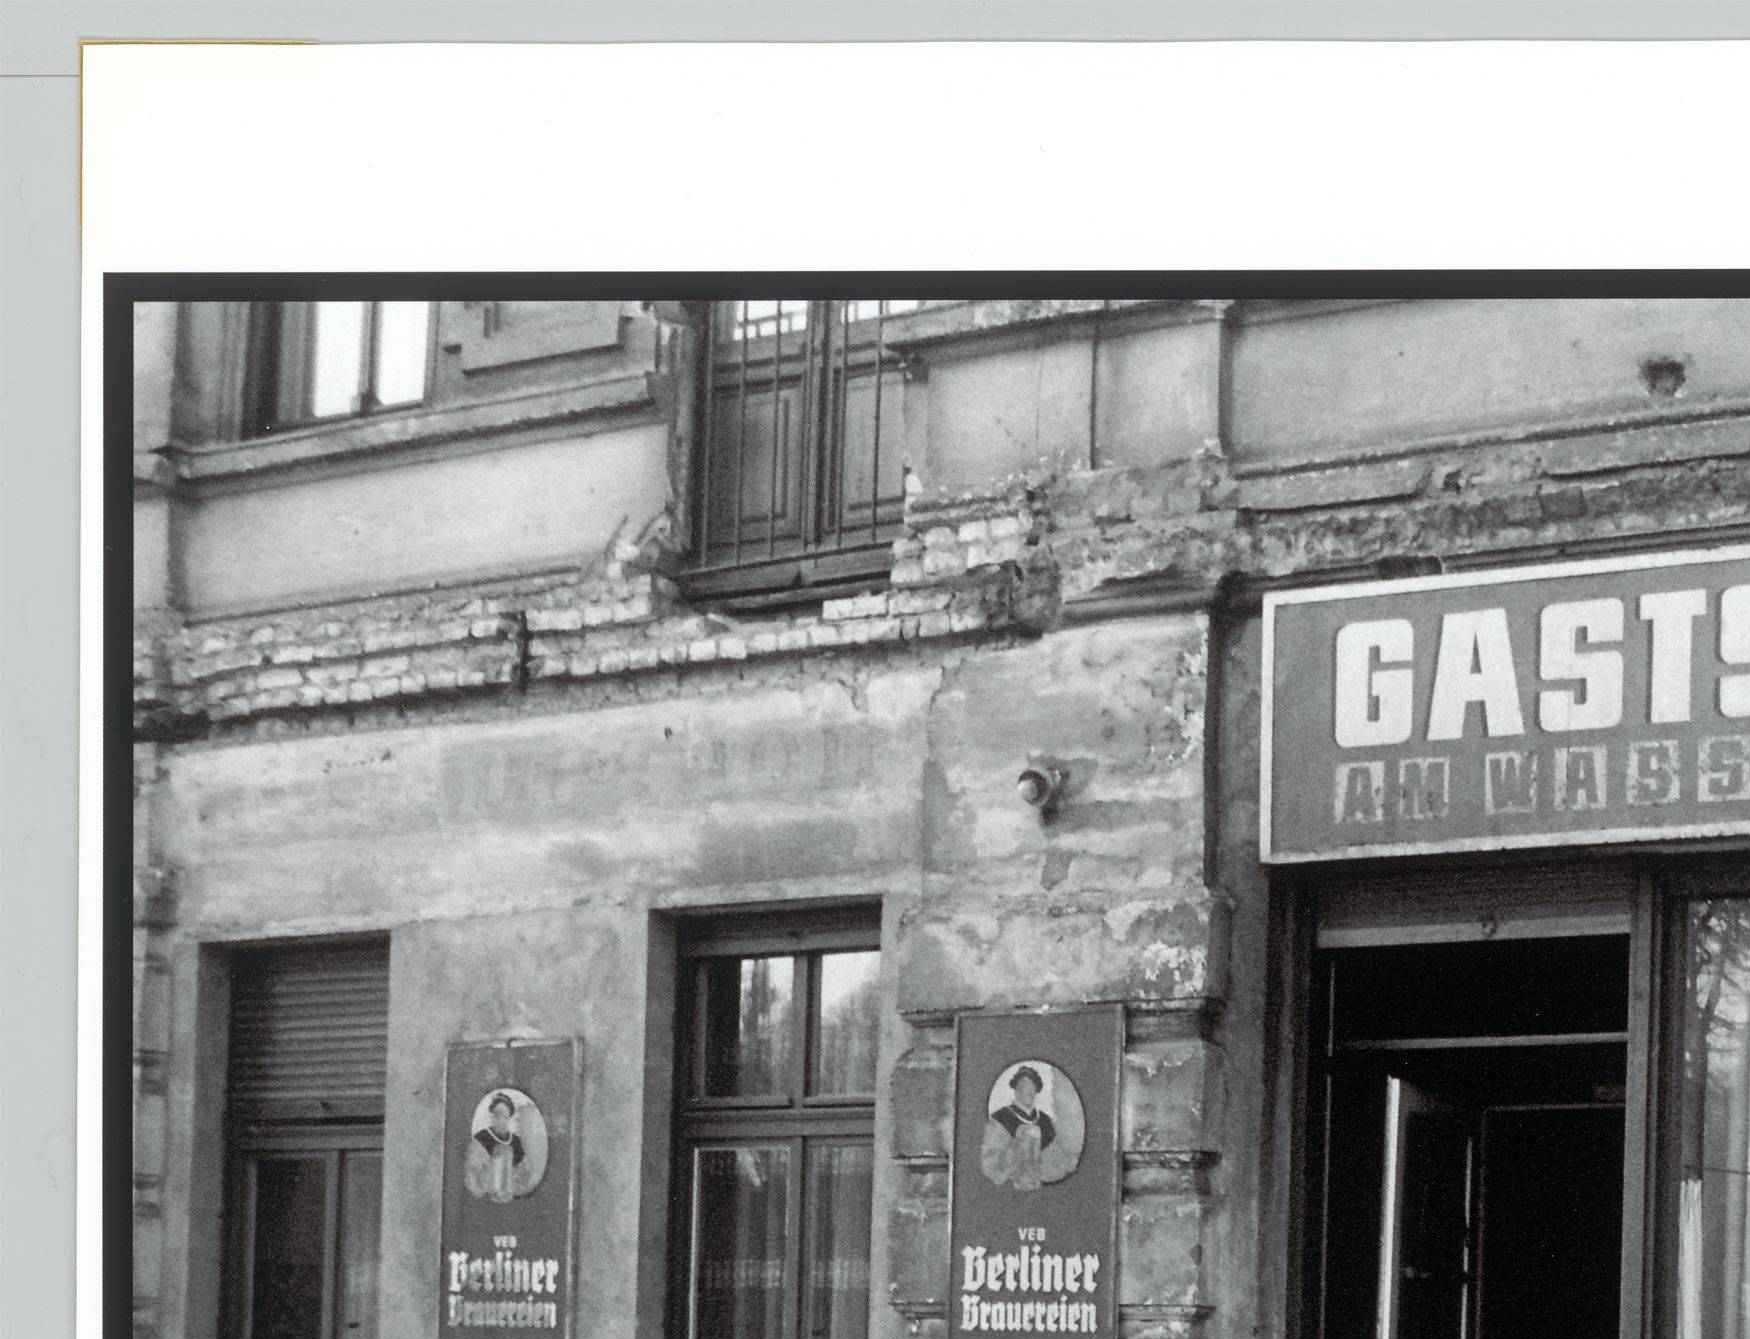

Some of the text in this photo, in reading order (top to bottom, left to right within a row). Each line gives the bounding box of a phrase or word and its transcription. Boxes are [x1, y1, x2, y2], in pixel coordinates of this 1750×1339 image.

[1334, 756, 1450, 824] AM
[493, 1235, 518, 1248] VEB
[1018, 1227, 1046, 1241] VEB
[448, 1250, 559, 1294] Berliner
[962, 1244, 1100, 1293] Berliner
[960, 1294, 1098, 1333] Brauereien
